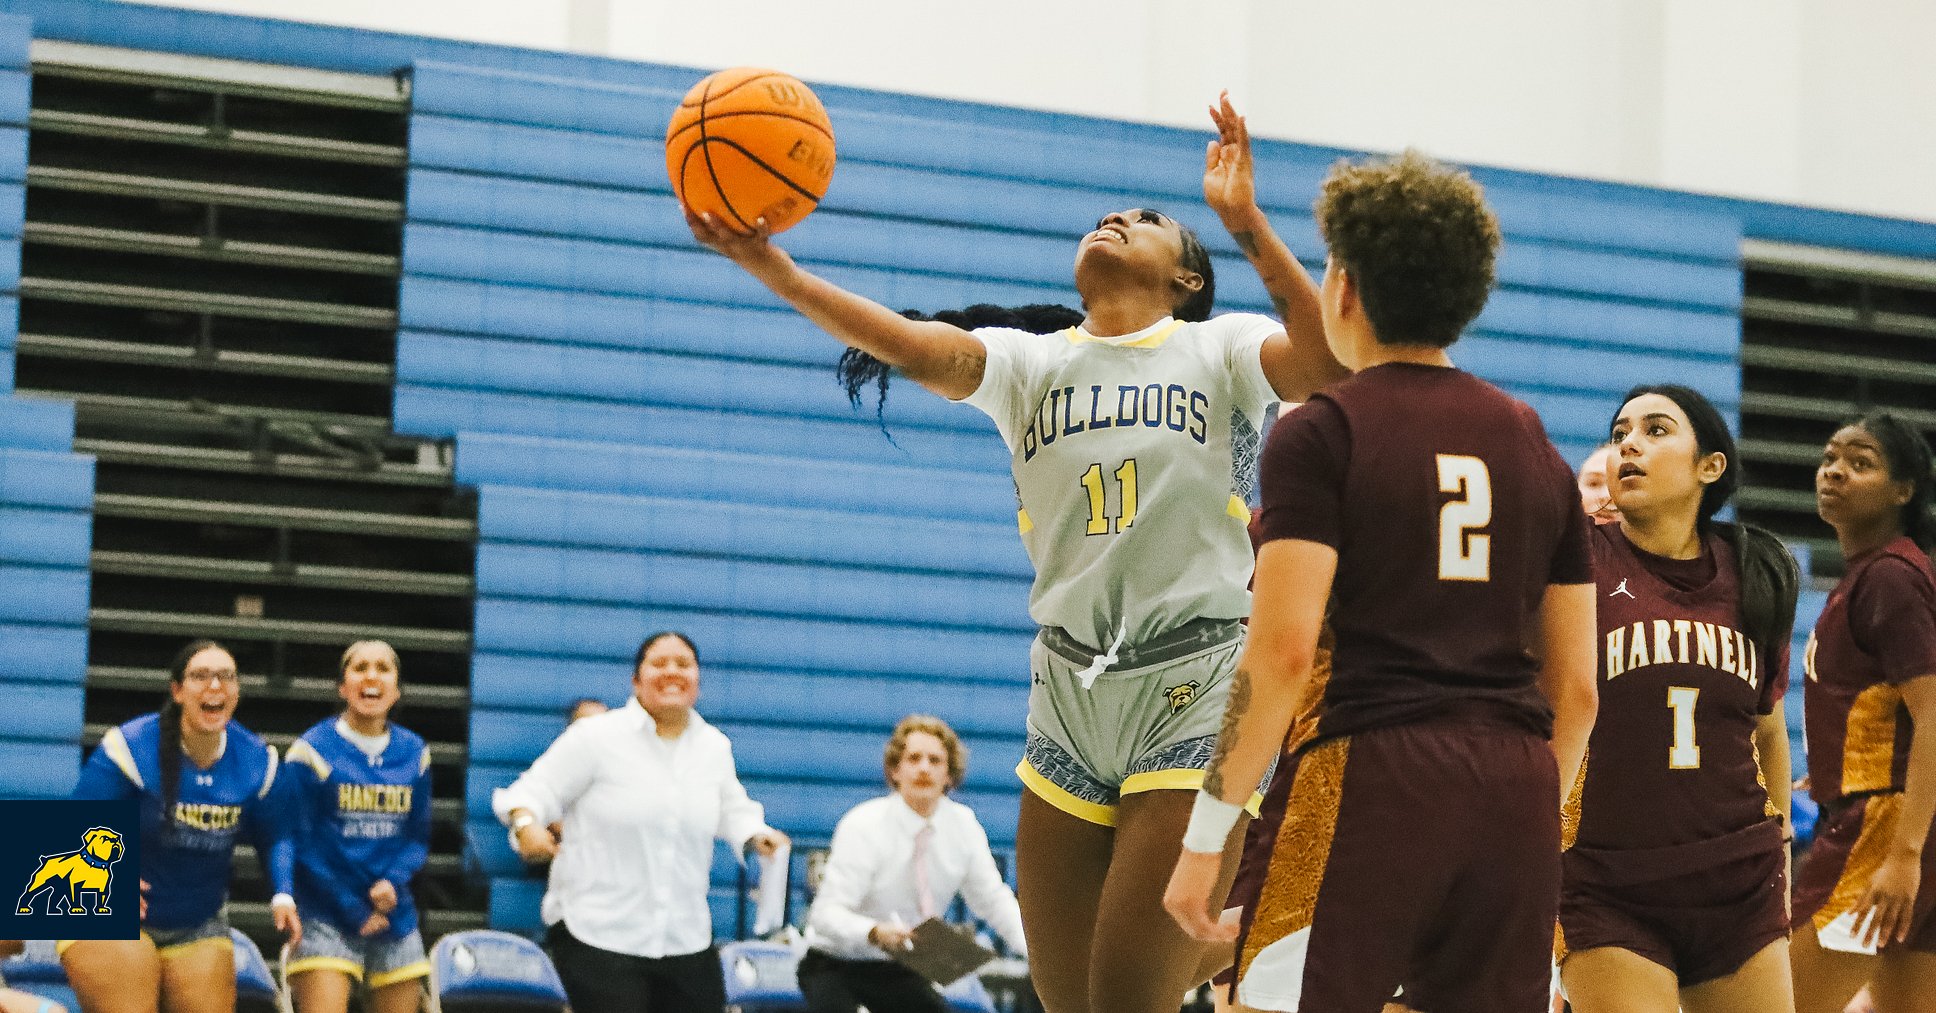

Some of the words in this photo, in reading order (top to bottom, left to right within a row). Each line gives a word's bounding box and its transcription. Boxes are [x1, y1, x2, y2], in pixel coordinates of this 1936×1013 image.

[1080, 458, 1138, 536] 11
[1435, 453, 1493, 582] 2
[1606, 619, 1758, 690] HARTNELL
[1667, 686, 1701, 769] 1
[175, 802, 242, 831] ANCOCK
[338, 783, 413, 813] HANCOCK
